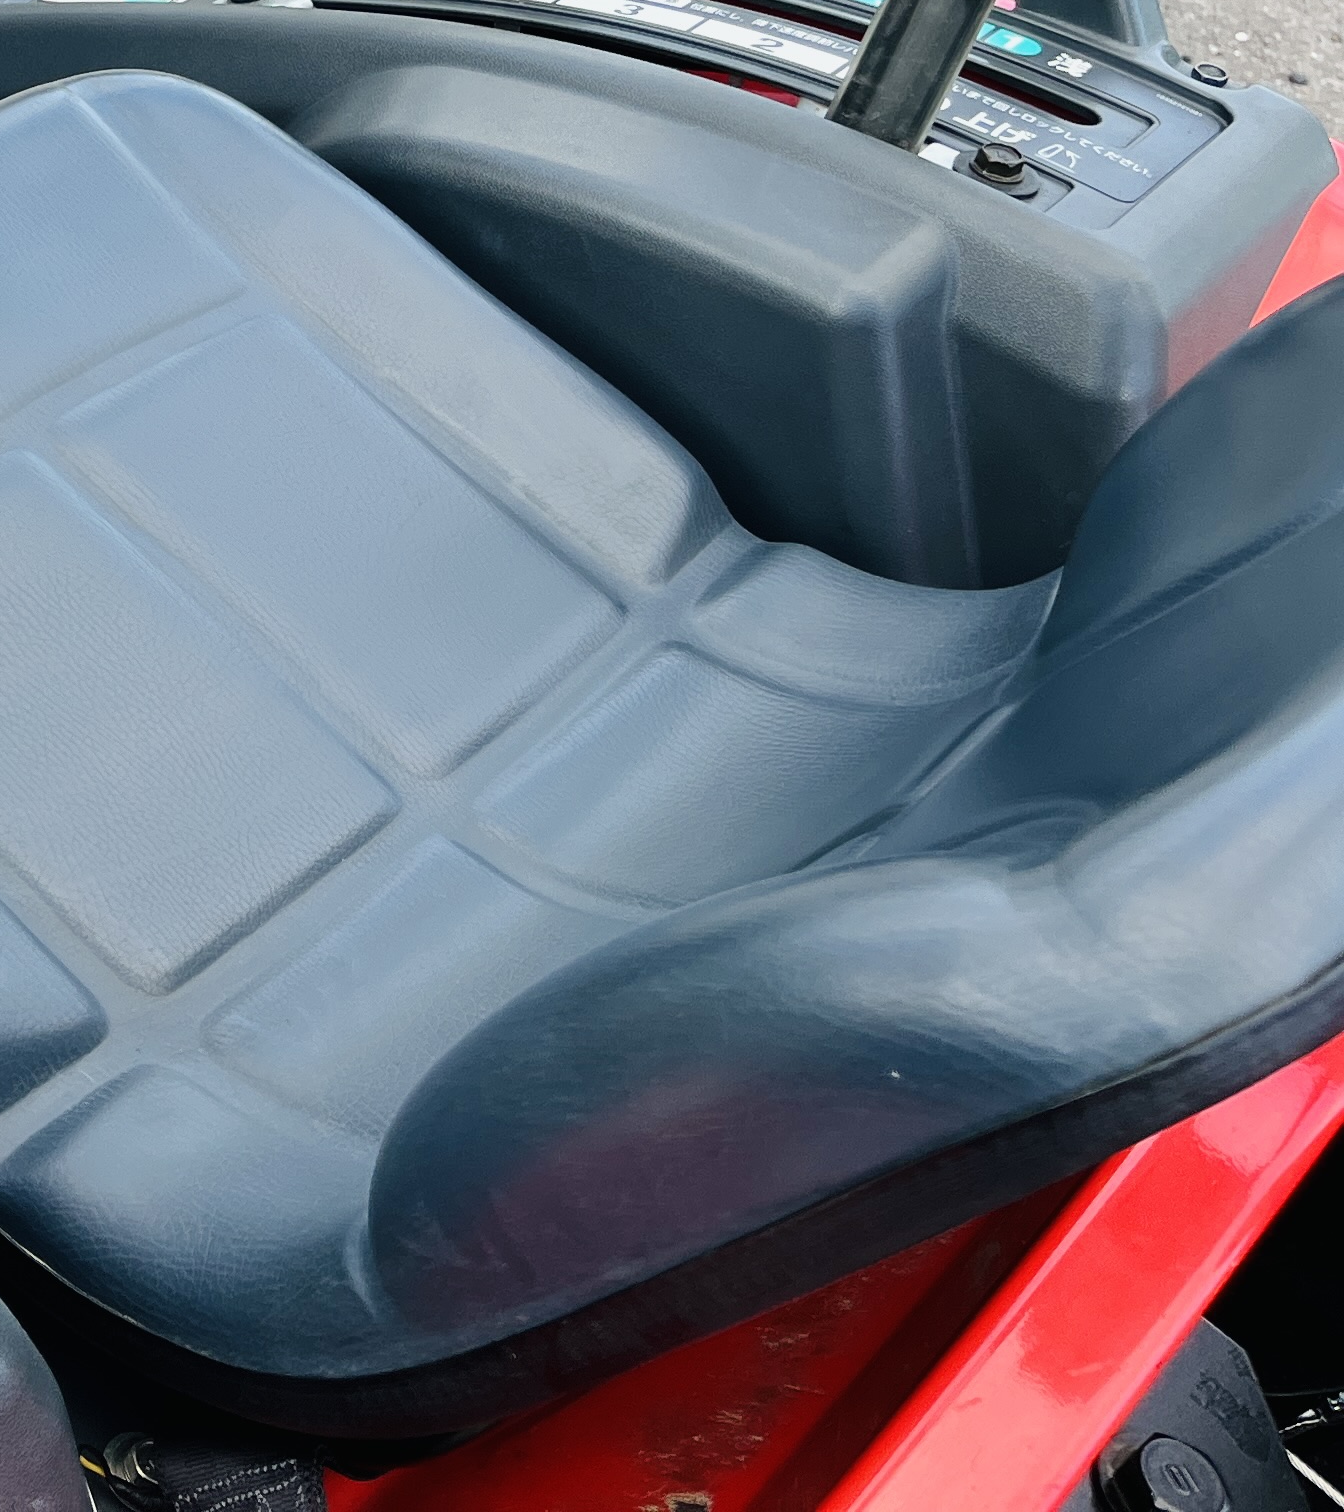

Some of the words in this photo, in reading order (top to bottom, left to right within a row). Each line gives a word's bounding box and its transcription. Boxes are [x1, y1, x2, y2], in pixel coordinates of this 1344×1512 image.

[613, 4, 645, 17] 3
[750, 37, 785, 53] 2
[952, 112, 1037, 143] 上げ
